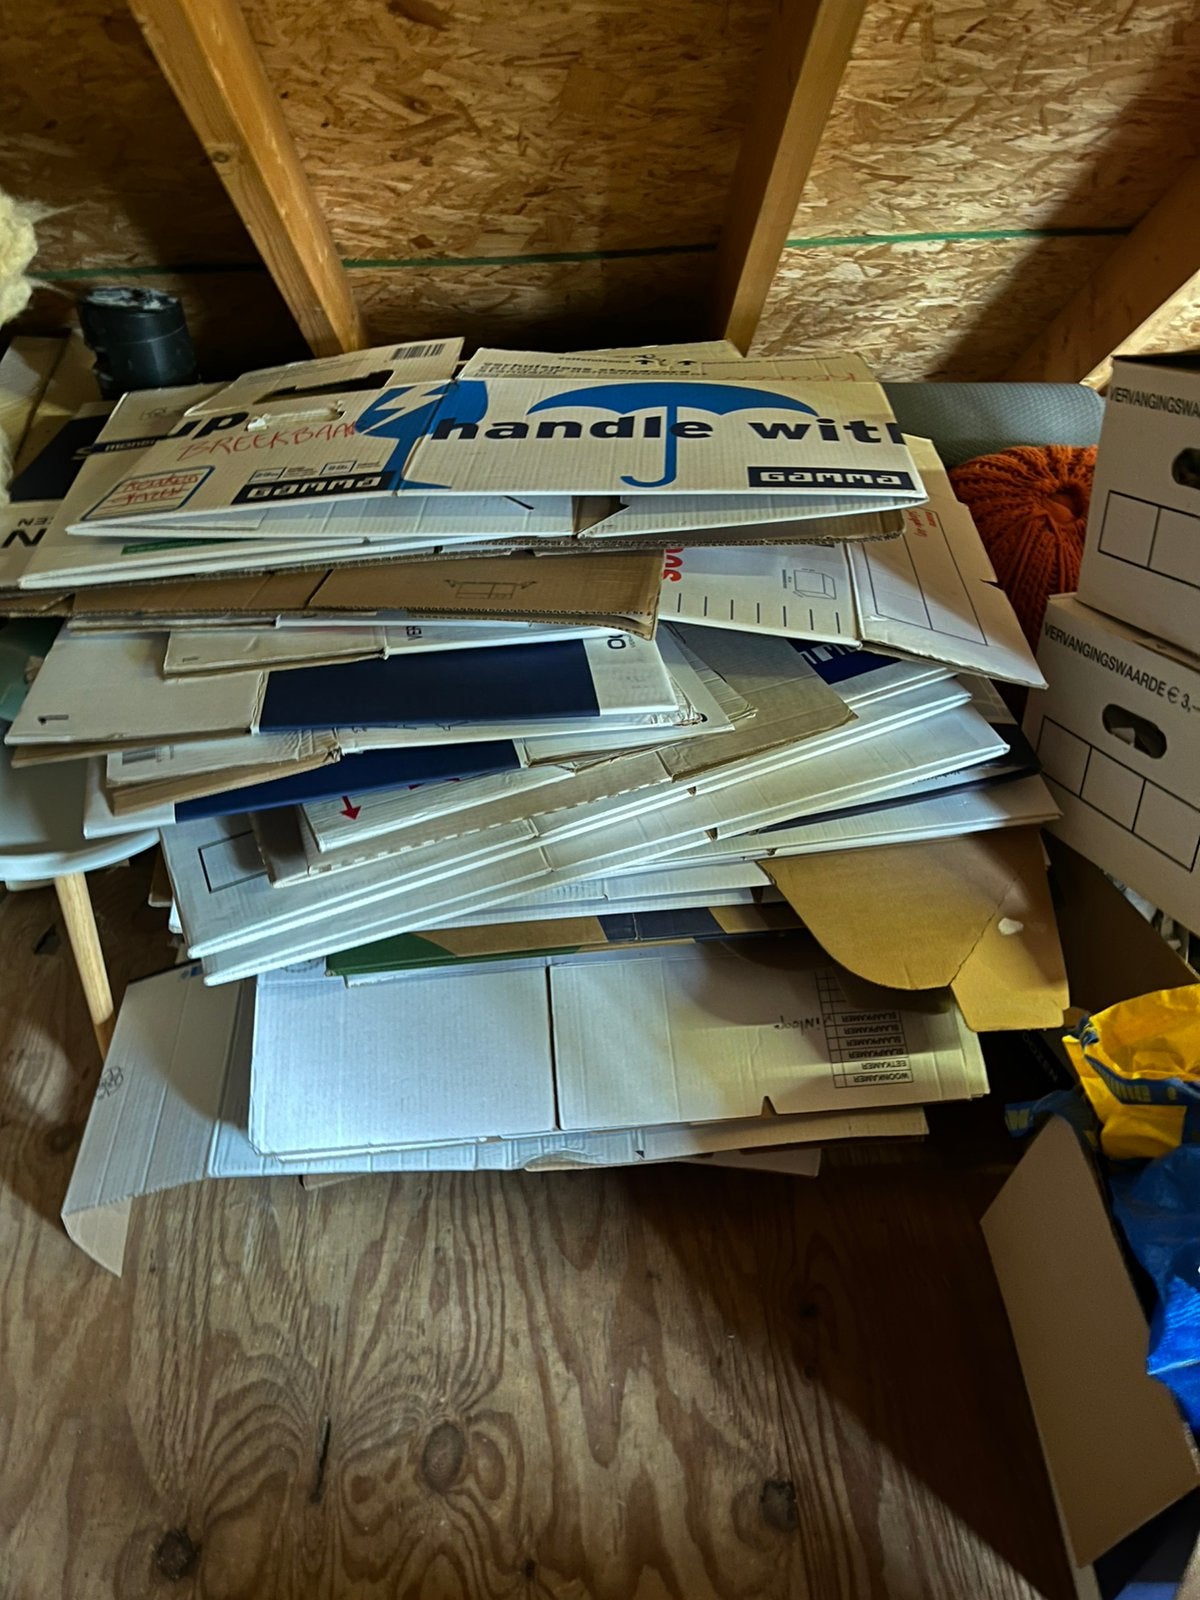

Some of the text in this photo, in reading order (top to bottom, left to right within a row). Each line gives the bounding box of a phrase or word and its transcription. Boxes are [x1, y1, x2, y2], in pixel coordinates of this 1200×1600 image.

[431, 416, 713, 440] handle
[1044, 622, 1167, 697] VERVANGINGSWAARDE
[1167, 685, 1180, 704] €
[861, 1060, 907, 1070] EETKAMER
[853, 1073, 909, 1083] WOONKAMER
